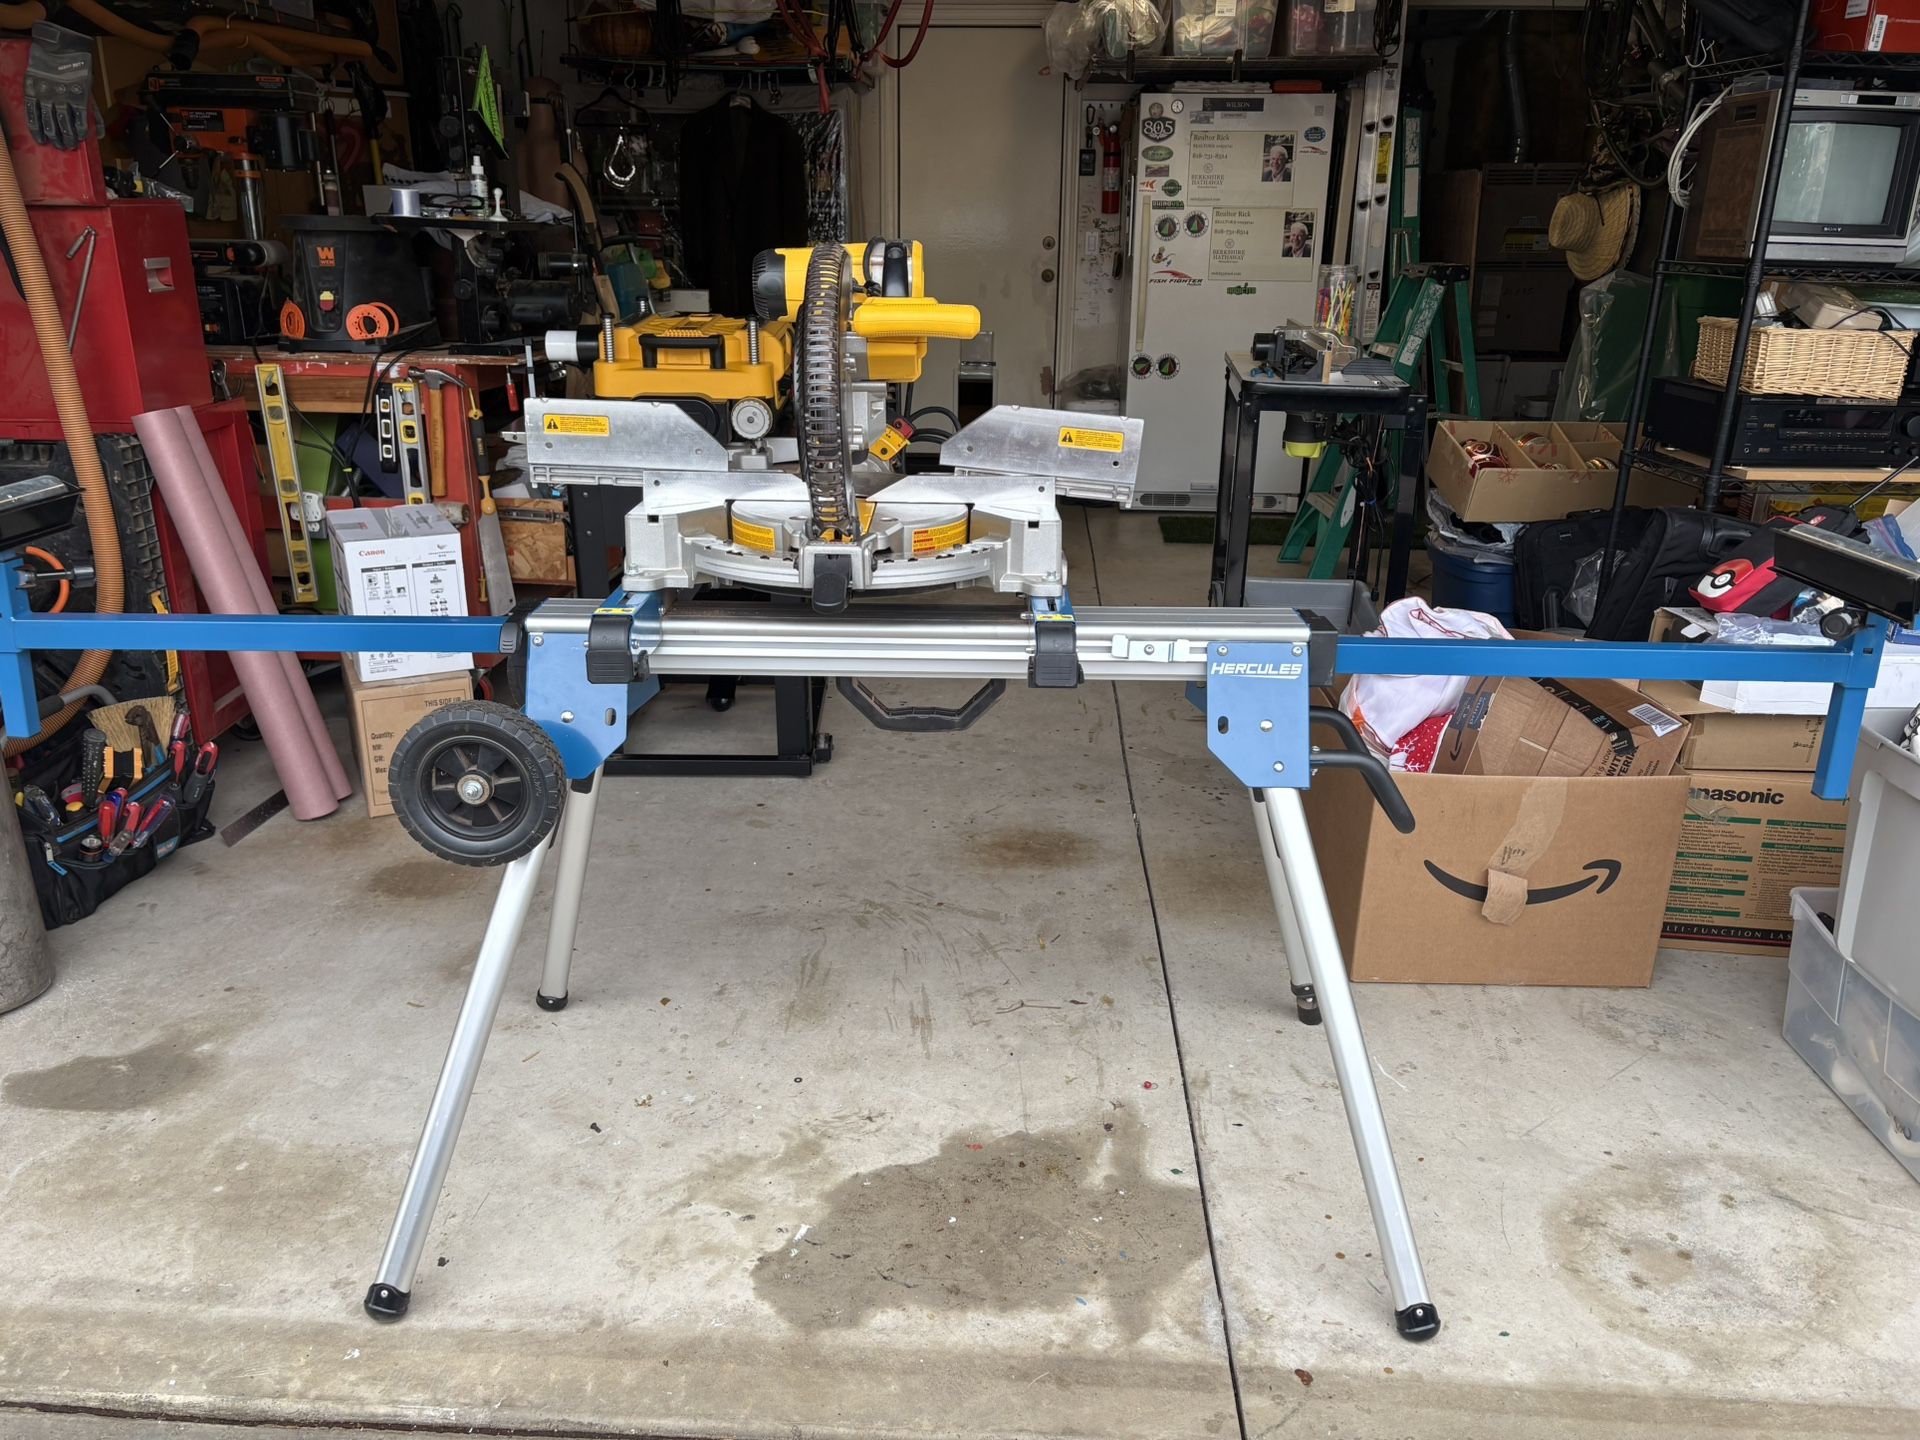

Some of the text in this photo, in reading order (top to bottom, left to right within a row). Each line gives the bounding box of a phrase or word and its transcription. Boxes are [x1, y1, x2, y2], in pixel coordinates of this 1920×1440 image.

[1143, 120, 1173, 135] 805
[358, 549, 385, 557] Canon
[1210, 662, 1303, 676] HERCULES
[424, 699, 438, 707] THIS
[439, 698, 452, 706] SIDE
